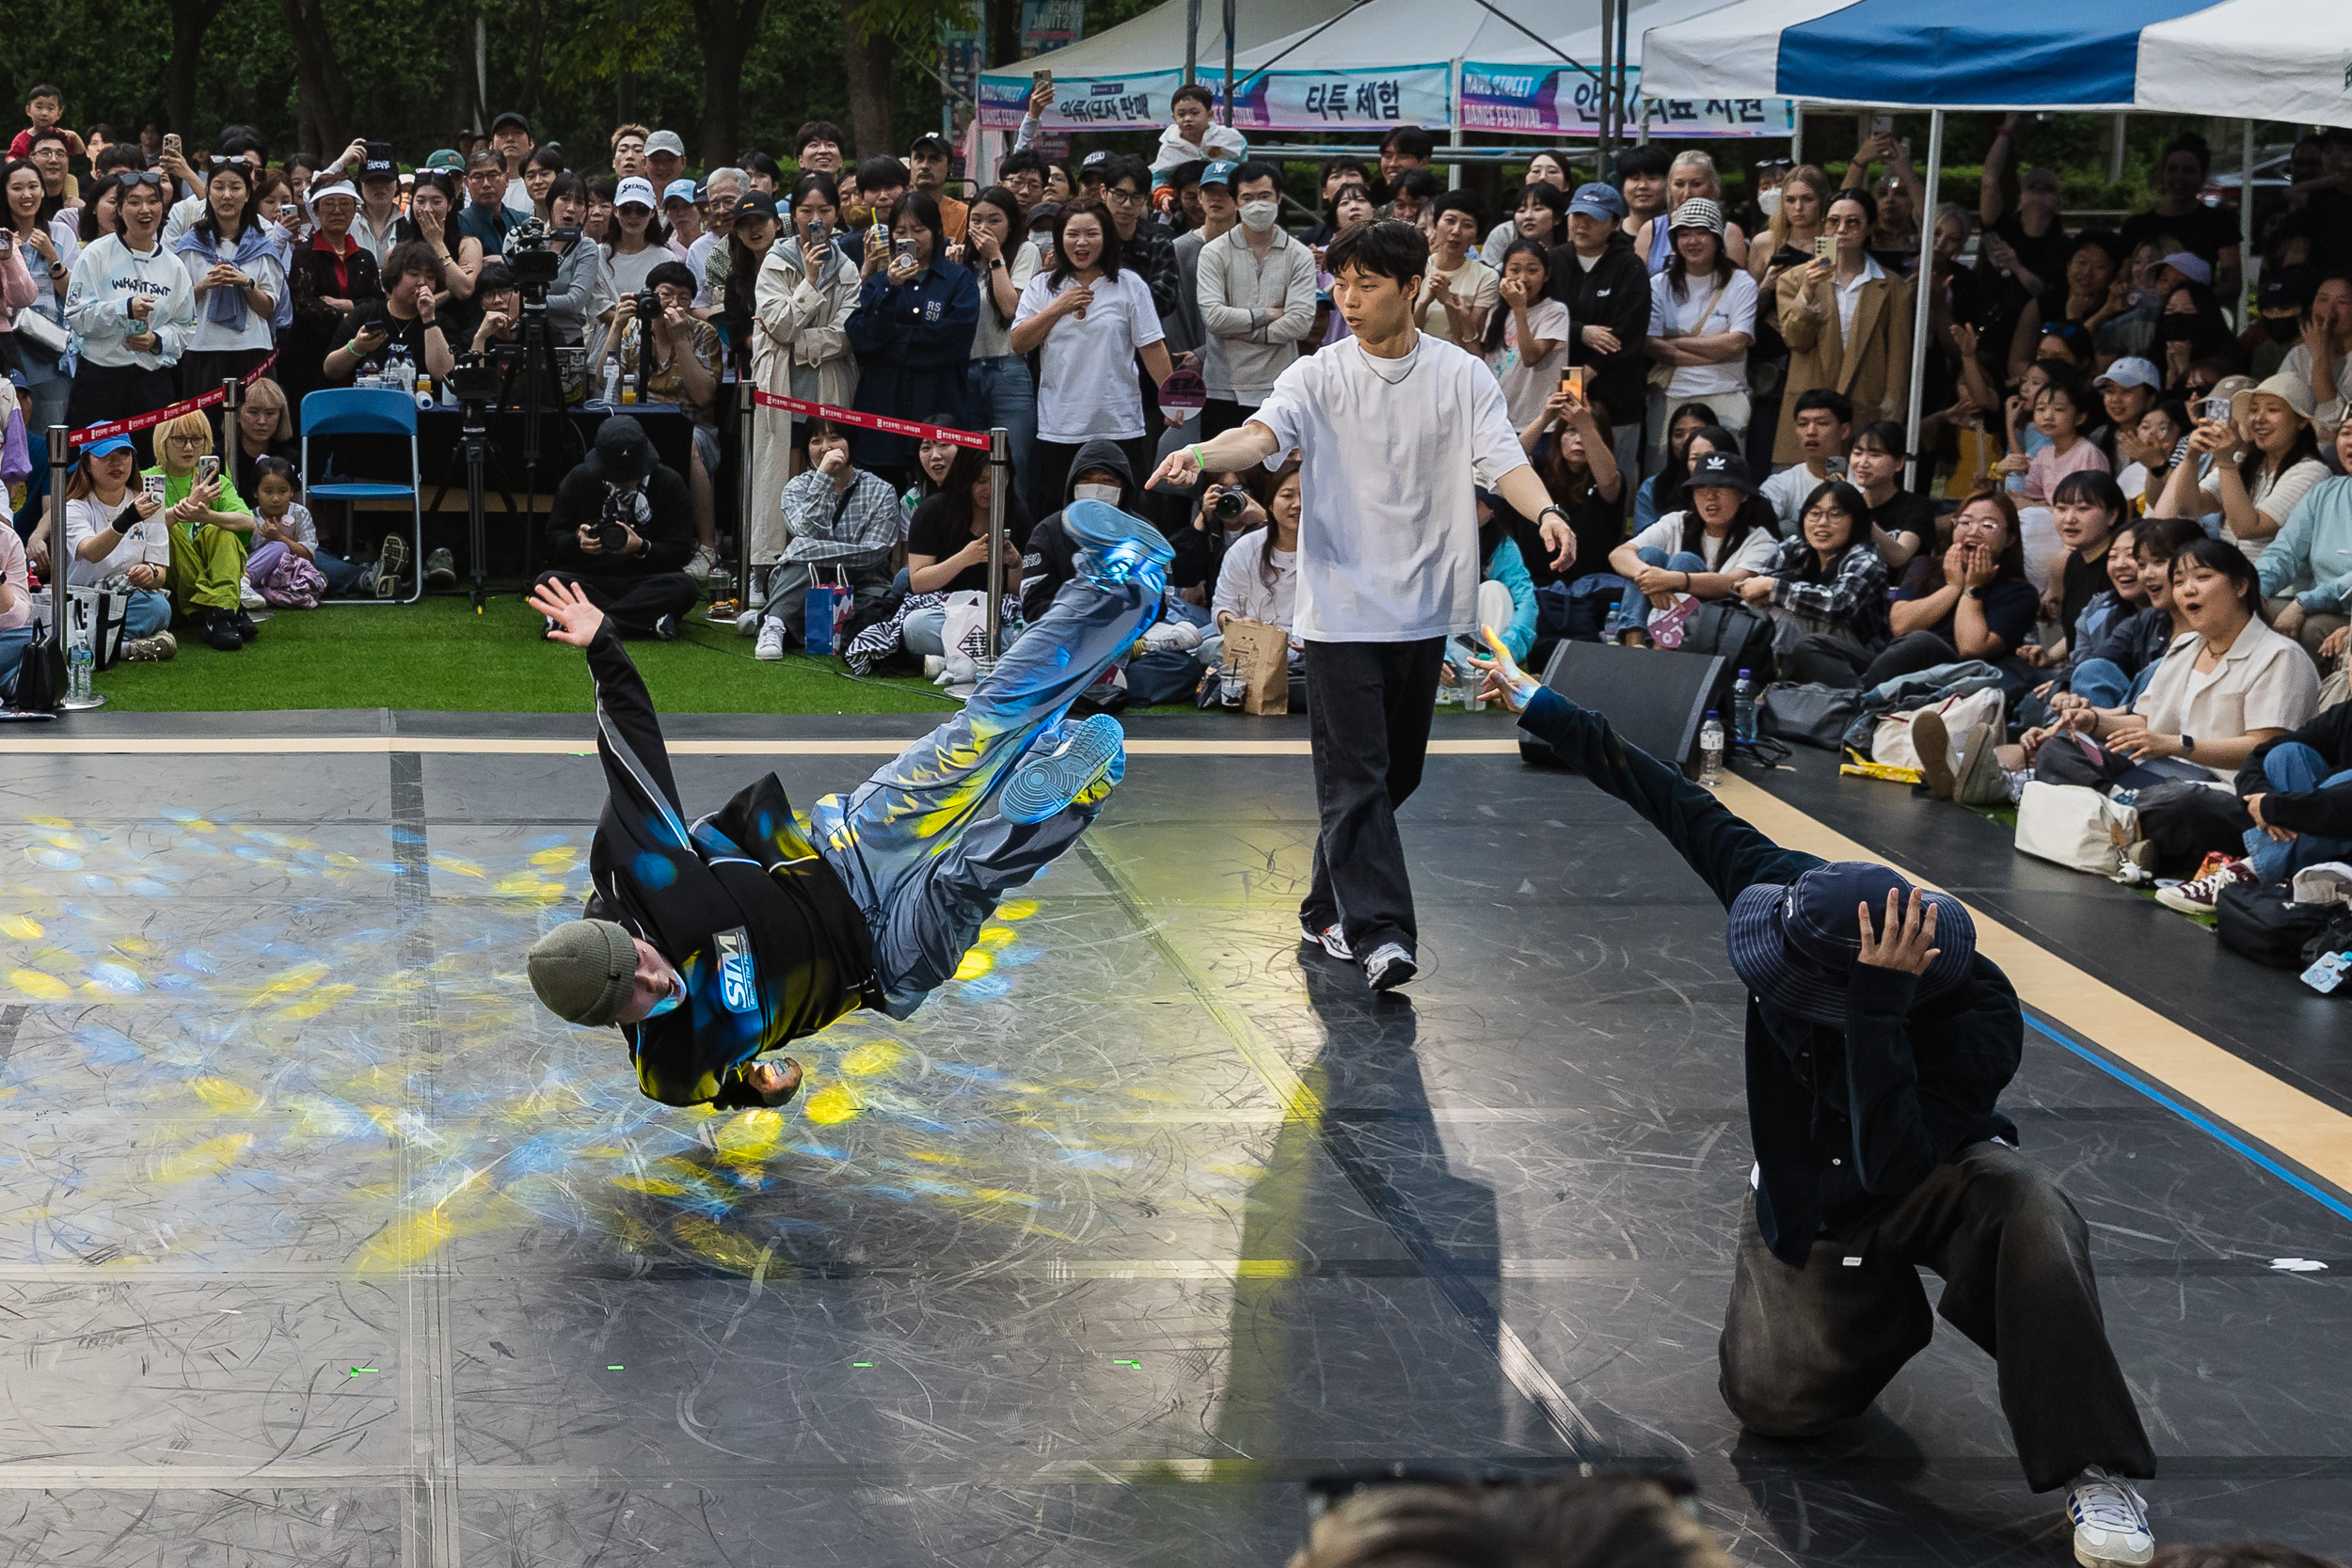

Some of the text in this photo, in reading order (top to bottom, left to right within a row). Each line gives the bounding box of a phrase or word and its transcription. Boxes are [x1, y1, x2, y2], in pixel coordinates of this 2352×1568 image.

[1492, 75, 1534, 99] STREET
[1305, 79, 1400, 121] 타투 체험
[1496, 105, 1541, 129] FESTIVAL
[927, 300, 942, 311] RS
